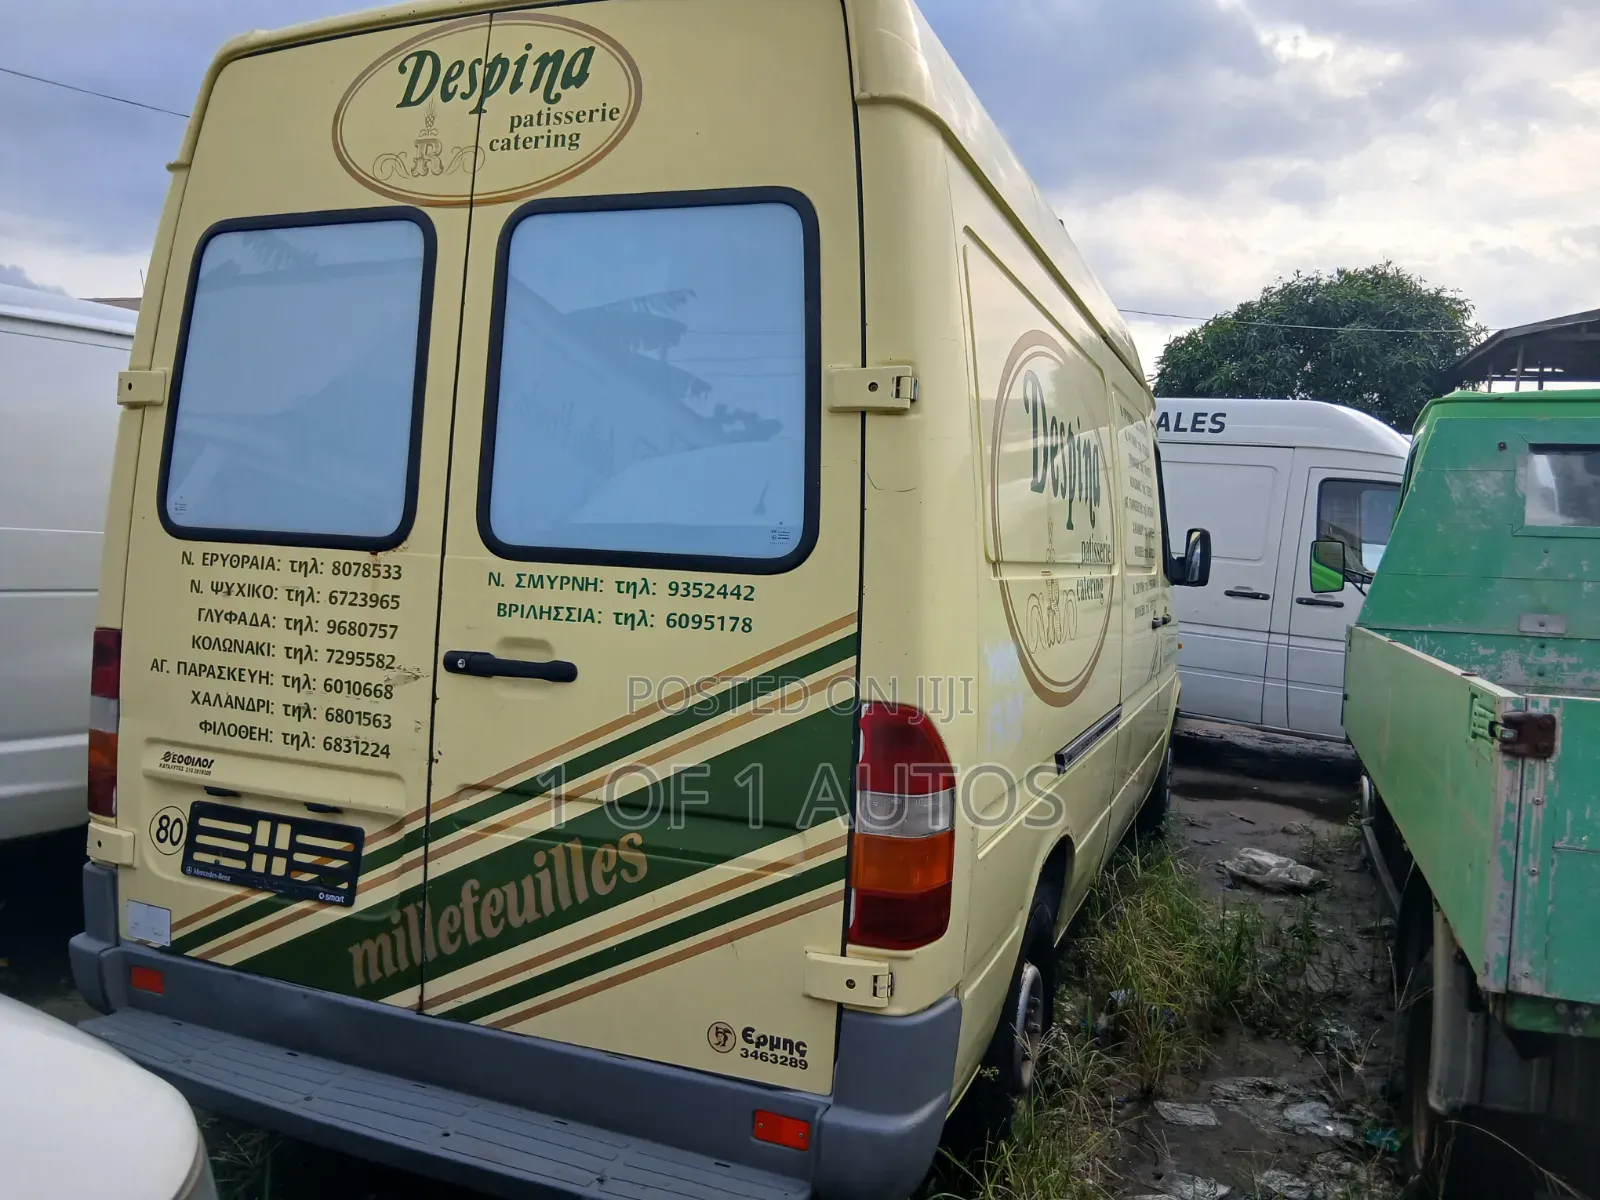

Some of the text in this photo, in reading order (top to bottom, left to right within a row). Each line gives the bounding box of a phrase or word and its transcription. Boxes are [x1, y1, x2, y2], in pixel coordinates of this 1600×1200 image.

[396, 42, 596, 115] Despina
[509, 102, 621, 133] patisserie
[489, 129, 581, 152] catering
[1156, 411, 1227, 434] ALES
[1023, 369, 1101, 531] Despina
[201, 552, 281, 572] ΕΡΥΘΡΑΙΑ:
[289, 558, 324, 578] τηλ:
[331, 561, 402, 580] 8078533
[1080, 533, 1111, 568] patisserie
[211, 580, 278, 600] ΨΥΧΙΚΟ:
[285, 587, 321, 607] τηλ:
[328, 590, 401, 610] 6723965
[515, 573, 604, 594] ΣΜΥΡΝΗ:
[615, 578, 657, 599] τηλ:
[667, 580, 756, 602] 9352442
[1077, 571, 1104, 605] catering
[197, 607, 399, 640] ΓΛΥΦΑΔΑ: τηλ: 9680757
[497, 602, 753, 634] ΒΡΙΛΗΣΣΙΑ: τηλ: 6095178
[191, 635, 396, 670] ΚΟΛΩΝΑΚΙ: τηλ: 7295582
[150, 658, 394, 700] ΑΓ. ΠΑΡΑΣΚΕΥΗ: τηλ: 6010668
[191, 690, 392, 730] ΧΑΛΑΝΔΡΙ: τηλ: 6801563
[198, 720, 391, 759] ΦΙΛΟΘΕΗ: τηλ: 6831224
[156, 814, 184, 847] 80
[193, 868, 231, 881] Mercedes-Benz
[325, 893, 344, 903] smart
[348, 832, 648, 989] millefeuilles
[740, 1047, 809, 1071] 3463289
